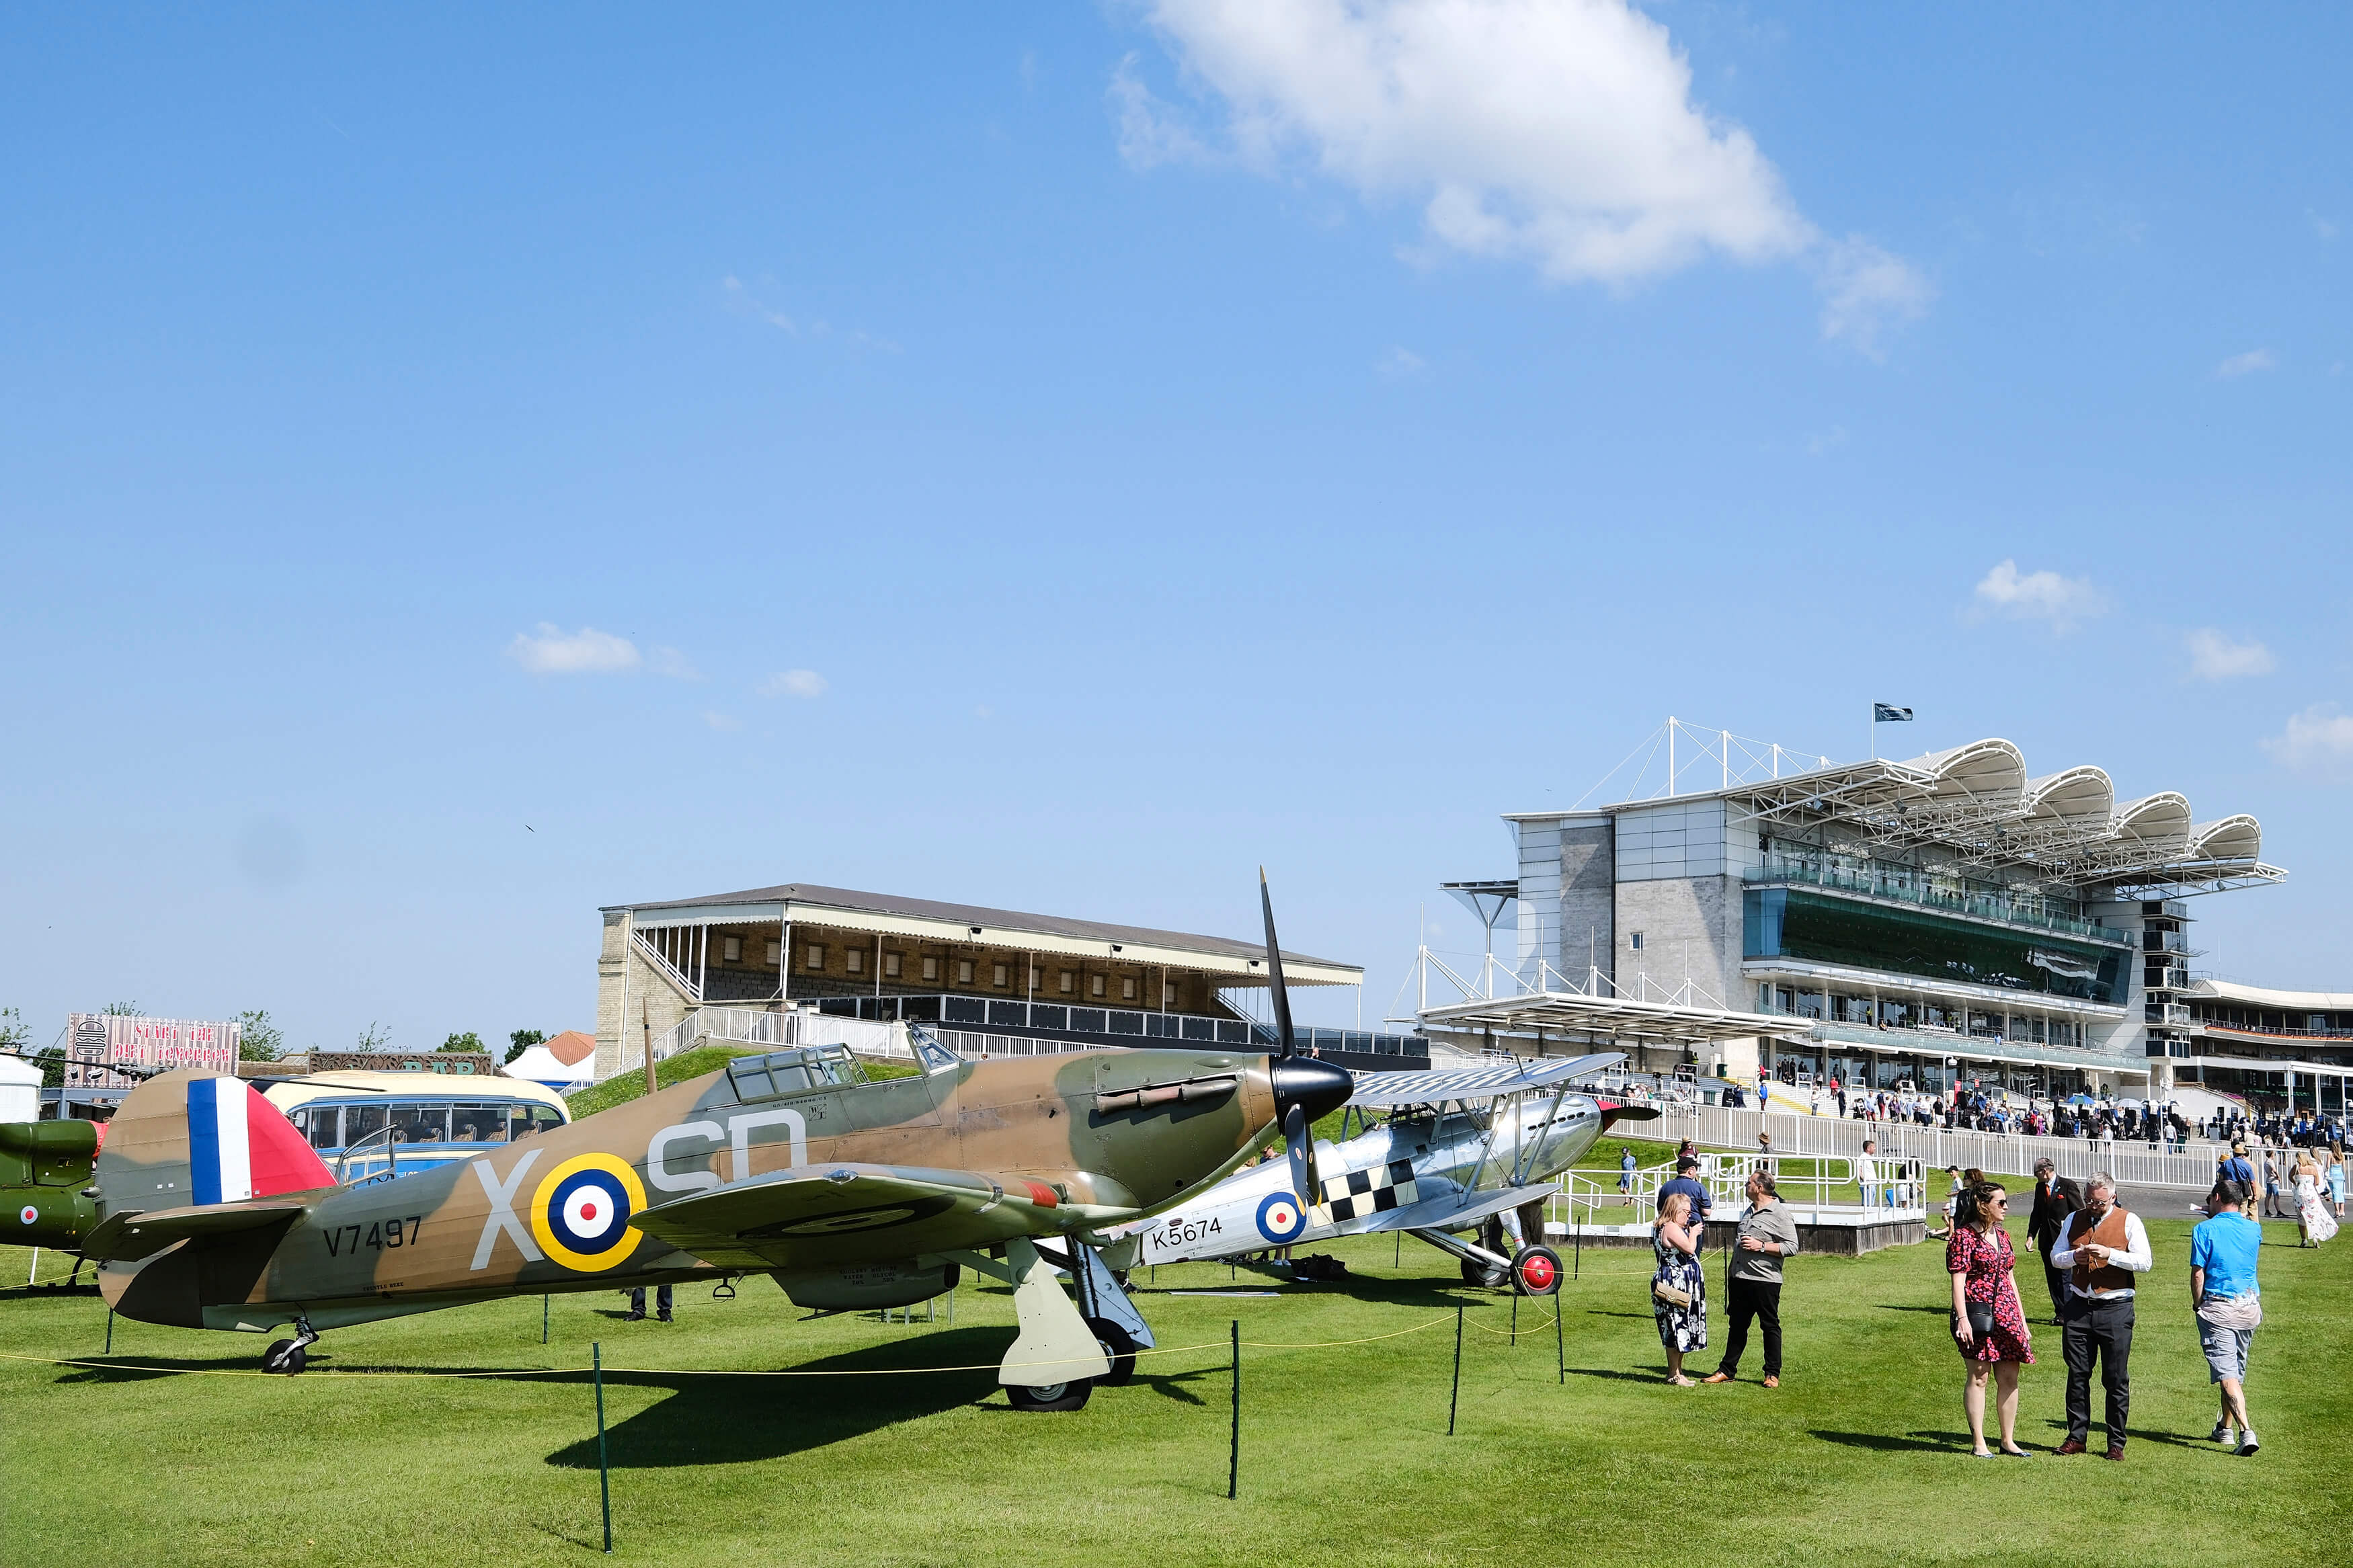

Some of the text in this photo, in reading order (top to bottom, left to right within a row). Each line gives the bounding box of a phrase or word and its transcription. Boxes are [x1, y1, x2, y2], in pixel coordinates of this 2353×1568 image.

[135, 1024, 214, 1042] START THE
[116, 1044, 231, 1063] DIET TOMORROW
[470, 1148, 545, 1271] X
[323, 1216, 422, 1257] V7497
[1152, 1217, 1222, 1250] K5674
